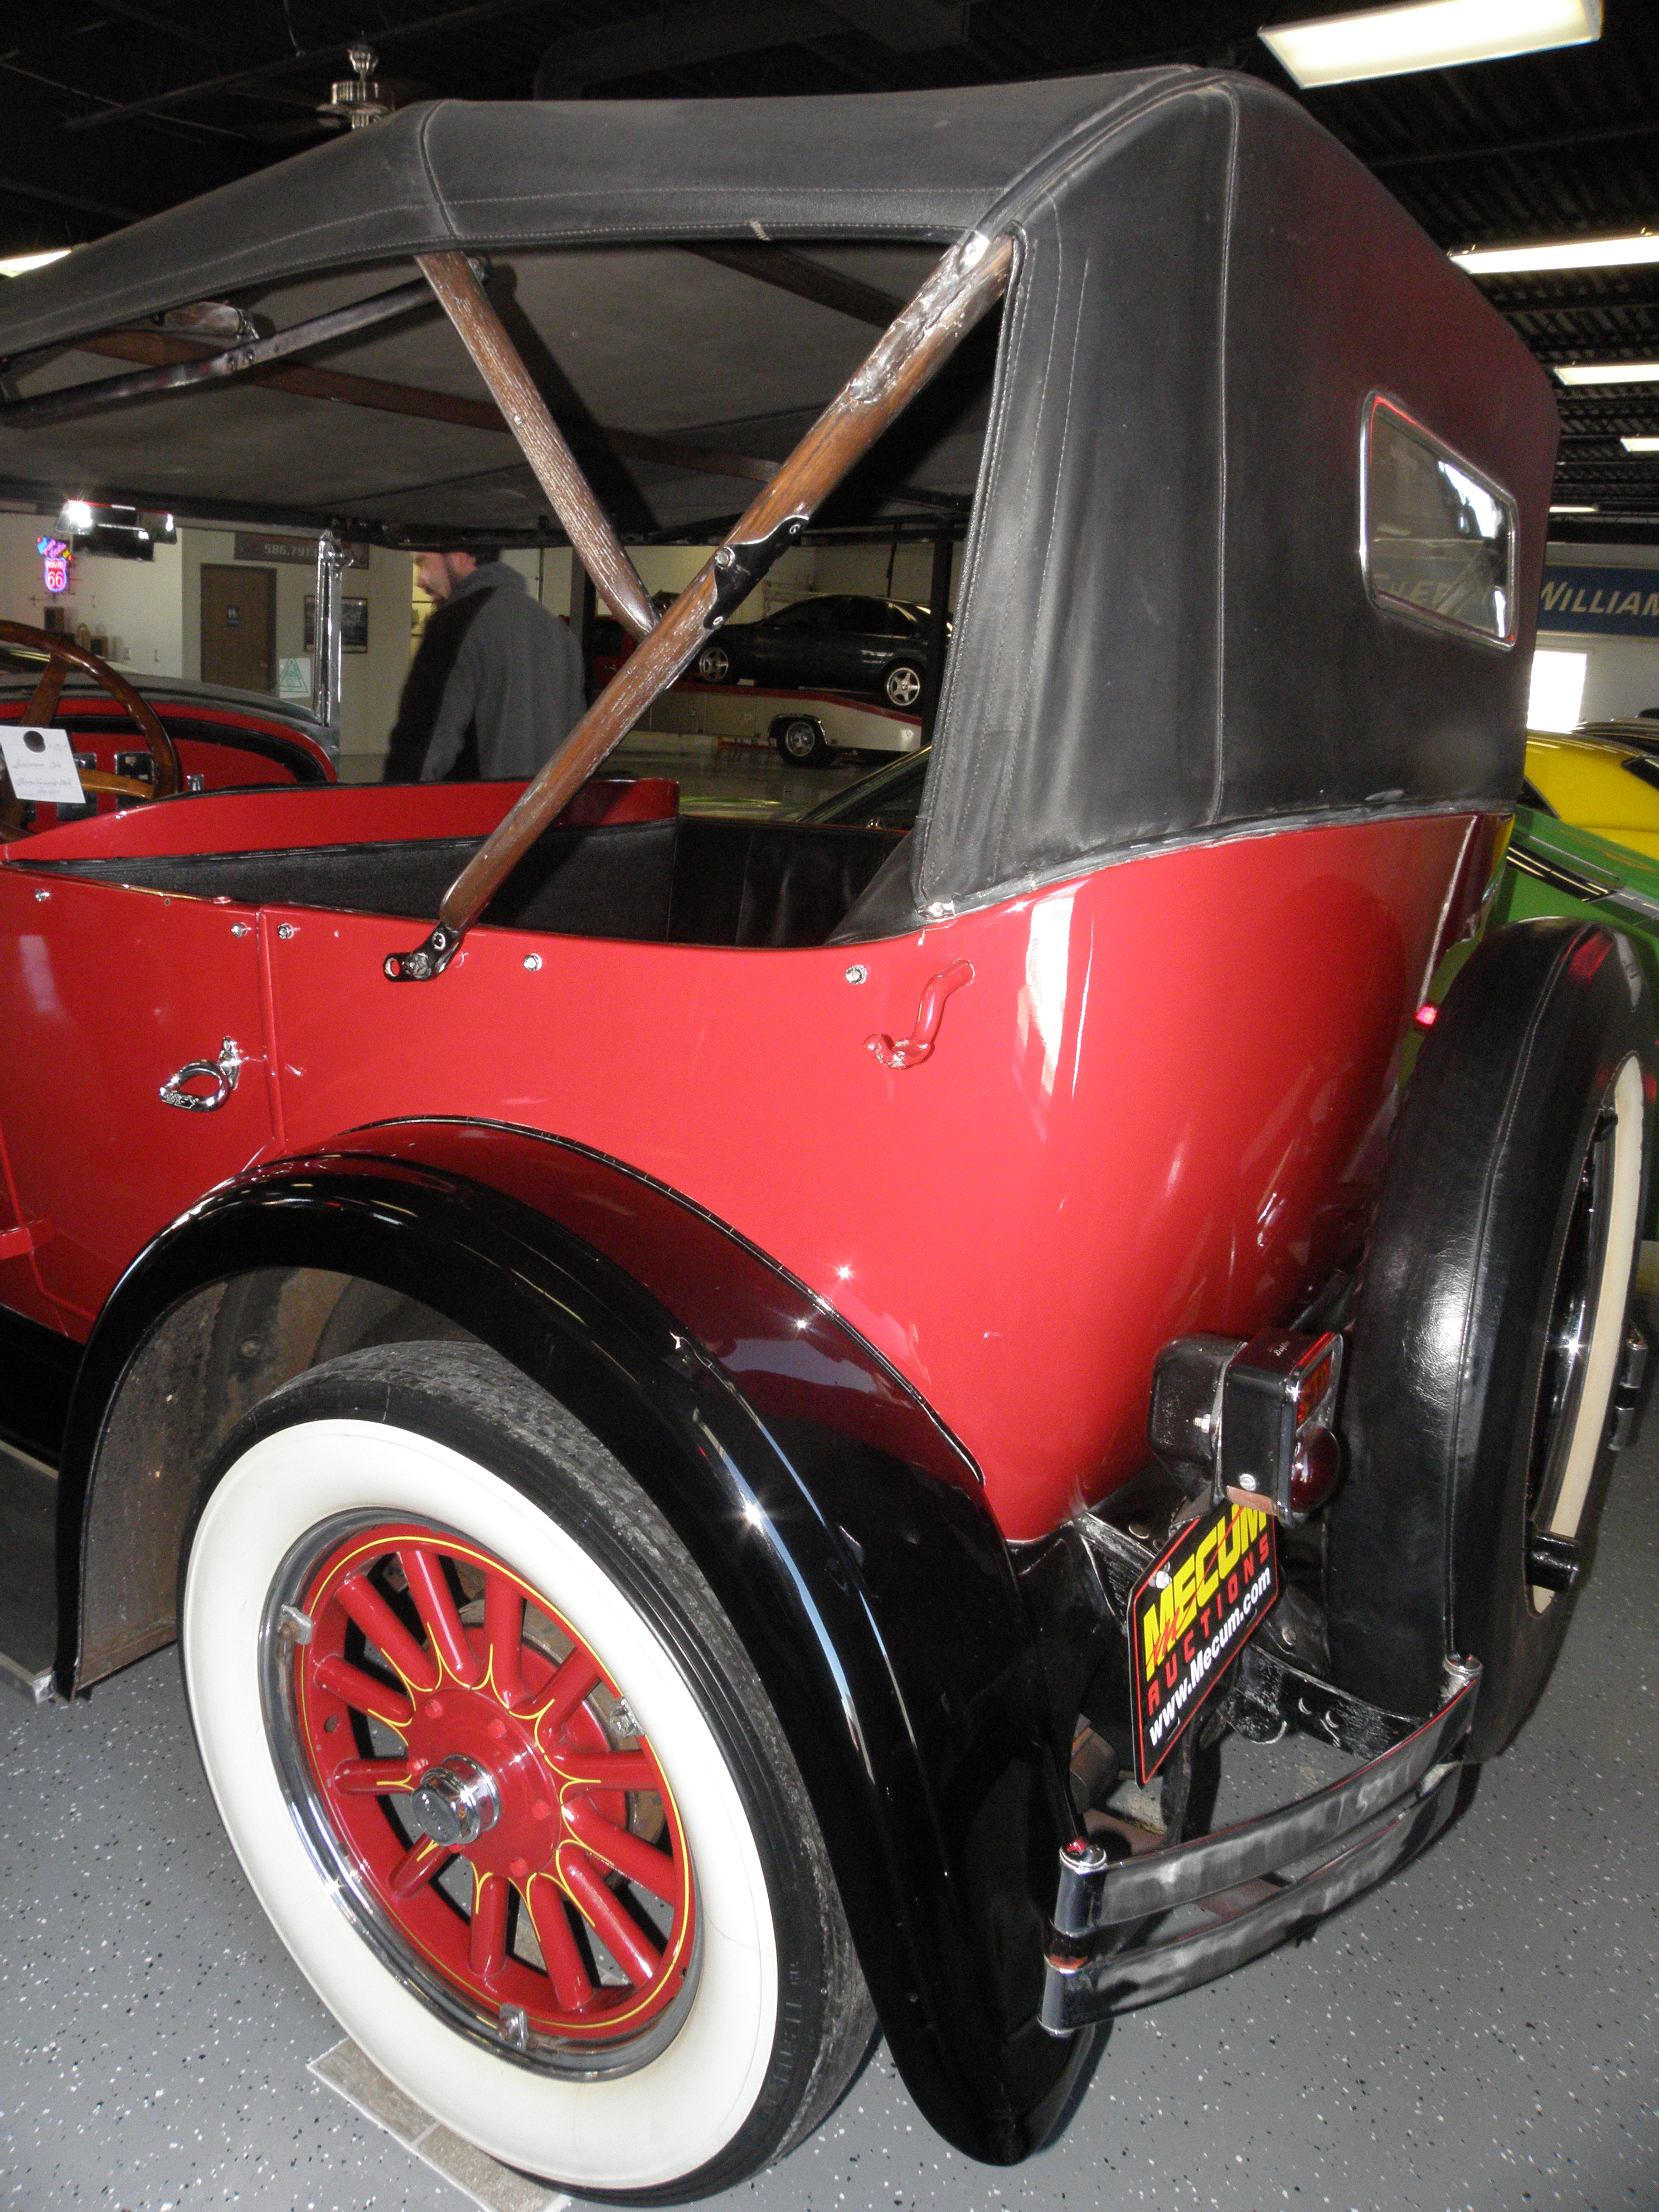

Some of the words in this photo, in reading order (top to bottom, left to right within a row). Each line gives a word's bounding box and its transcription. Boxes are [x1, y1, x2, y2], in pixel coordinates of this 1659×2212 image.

[47, 570, 64, 589] 66
[1143, 1503, 1267, 1682] MECUM
[1147, 1532, 1269, 1716] AUCTIONS
[1149, 1566, 1270, 1747] www.Mecum.com
